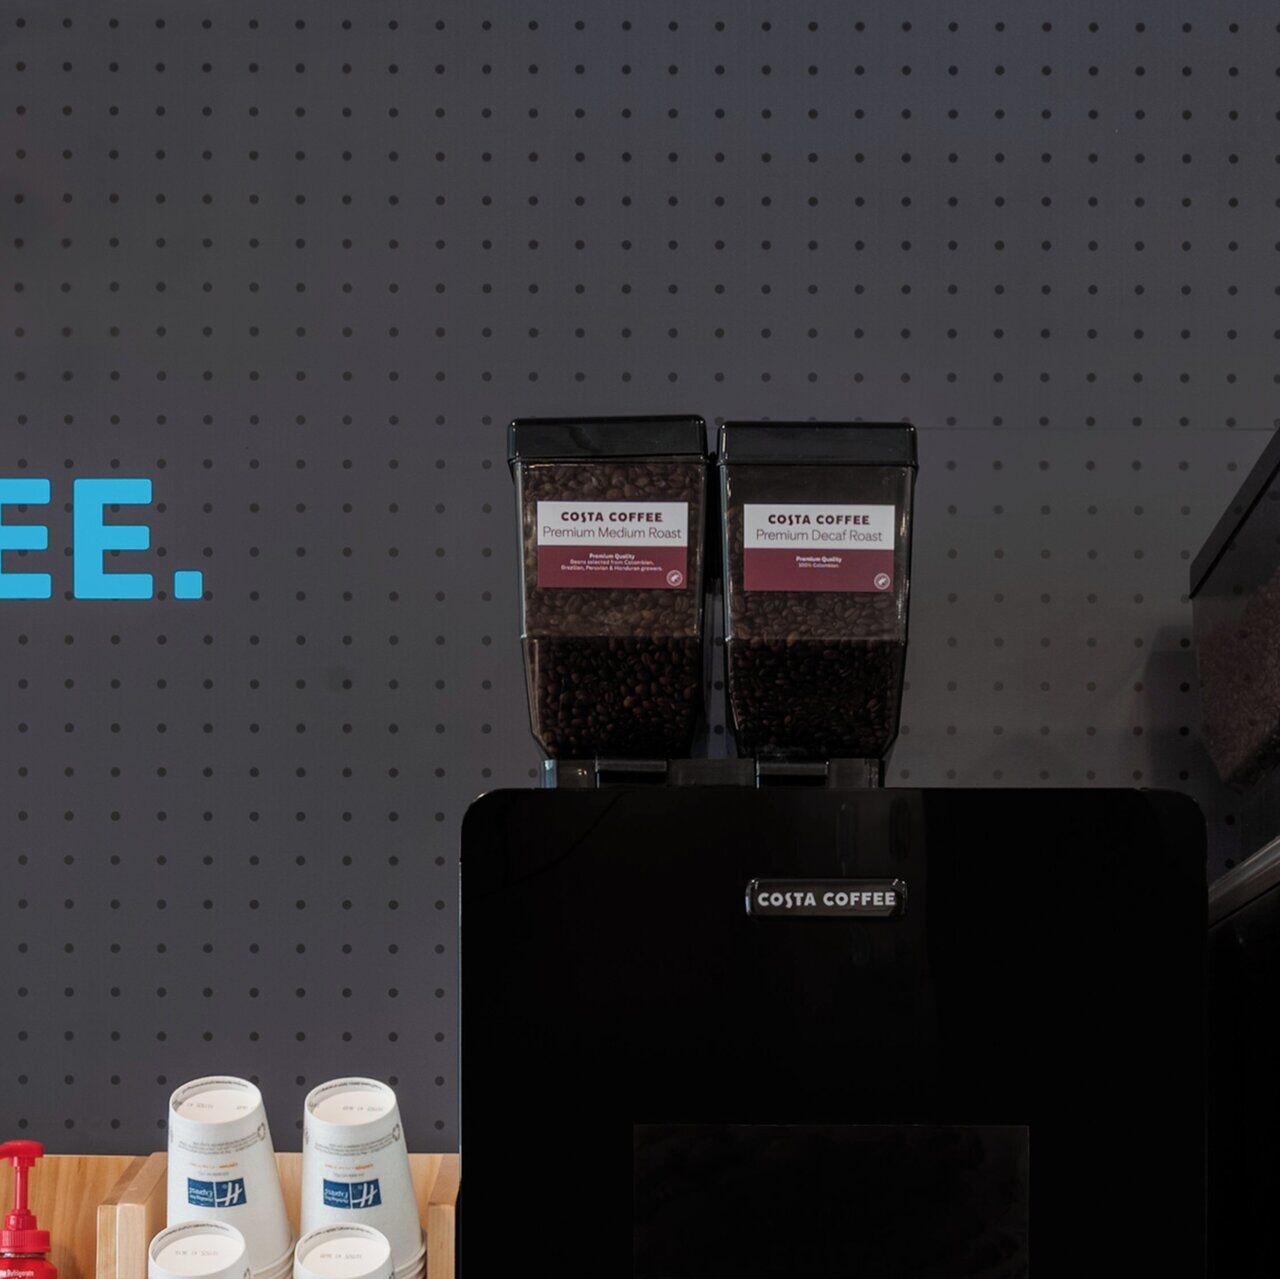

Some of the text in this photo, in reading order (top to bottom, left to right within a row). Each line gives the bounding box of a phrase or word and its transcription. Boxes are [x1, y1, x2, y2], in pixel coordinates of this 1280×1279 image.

[561, 511, 663, 523] COSTA COFFEE
[768, 514, 870, 526] COSTA COFFEE
[542, 526, 682, 539] Premium Medium Roast
[756, 529, 882, 542] Premium Decaf Roast
[758, 892, 896, 909] COSTA COFFEE
